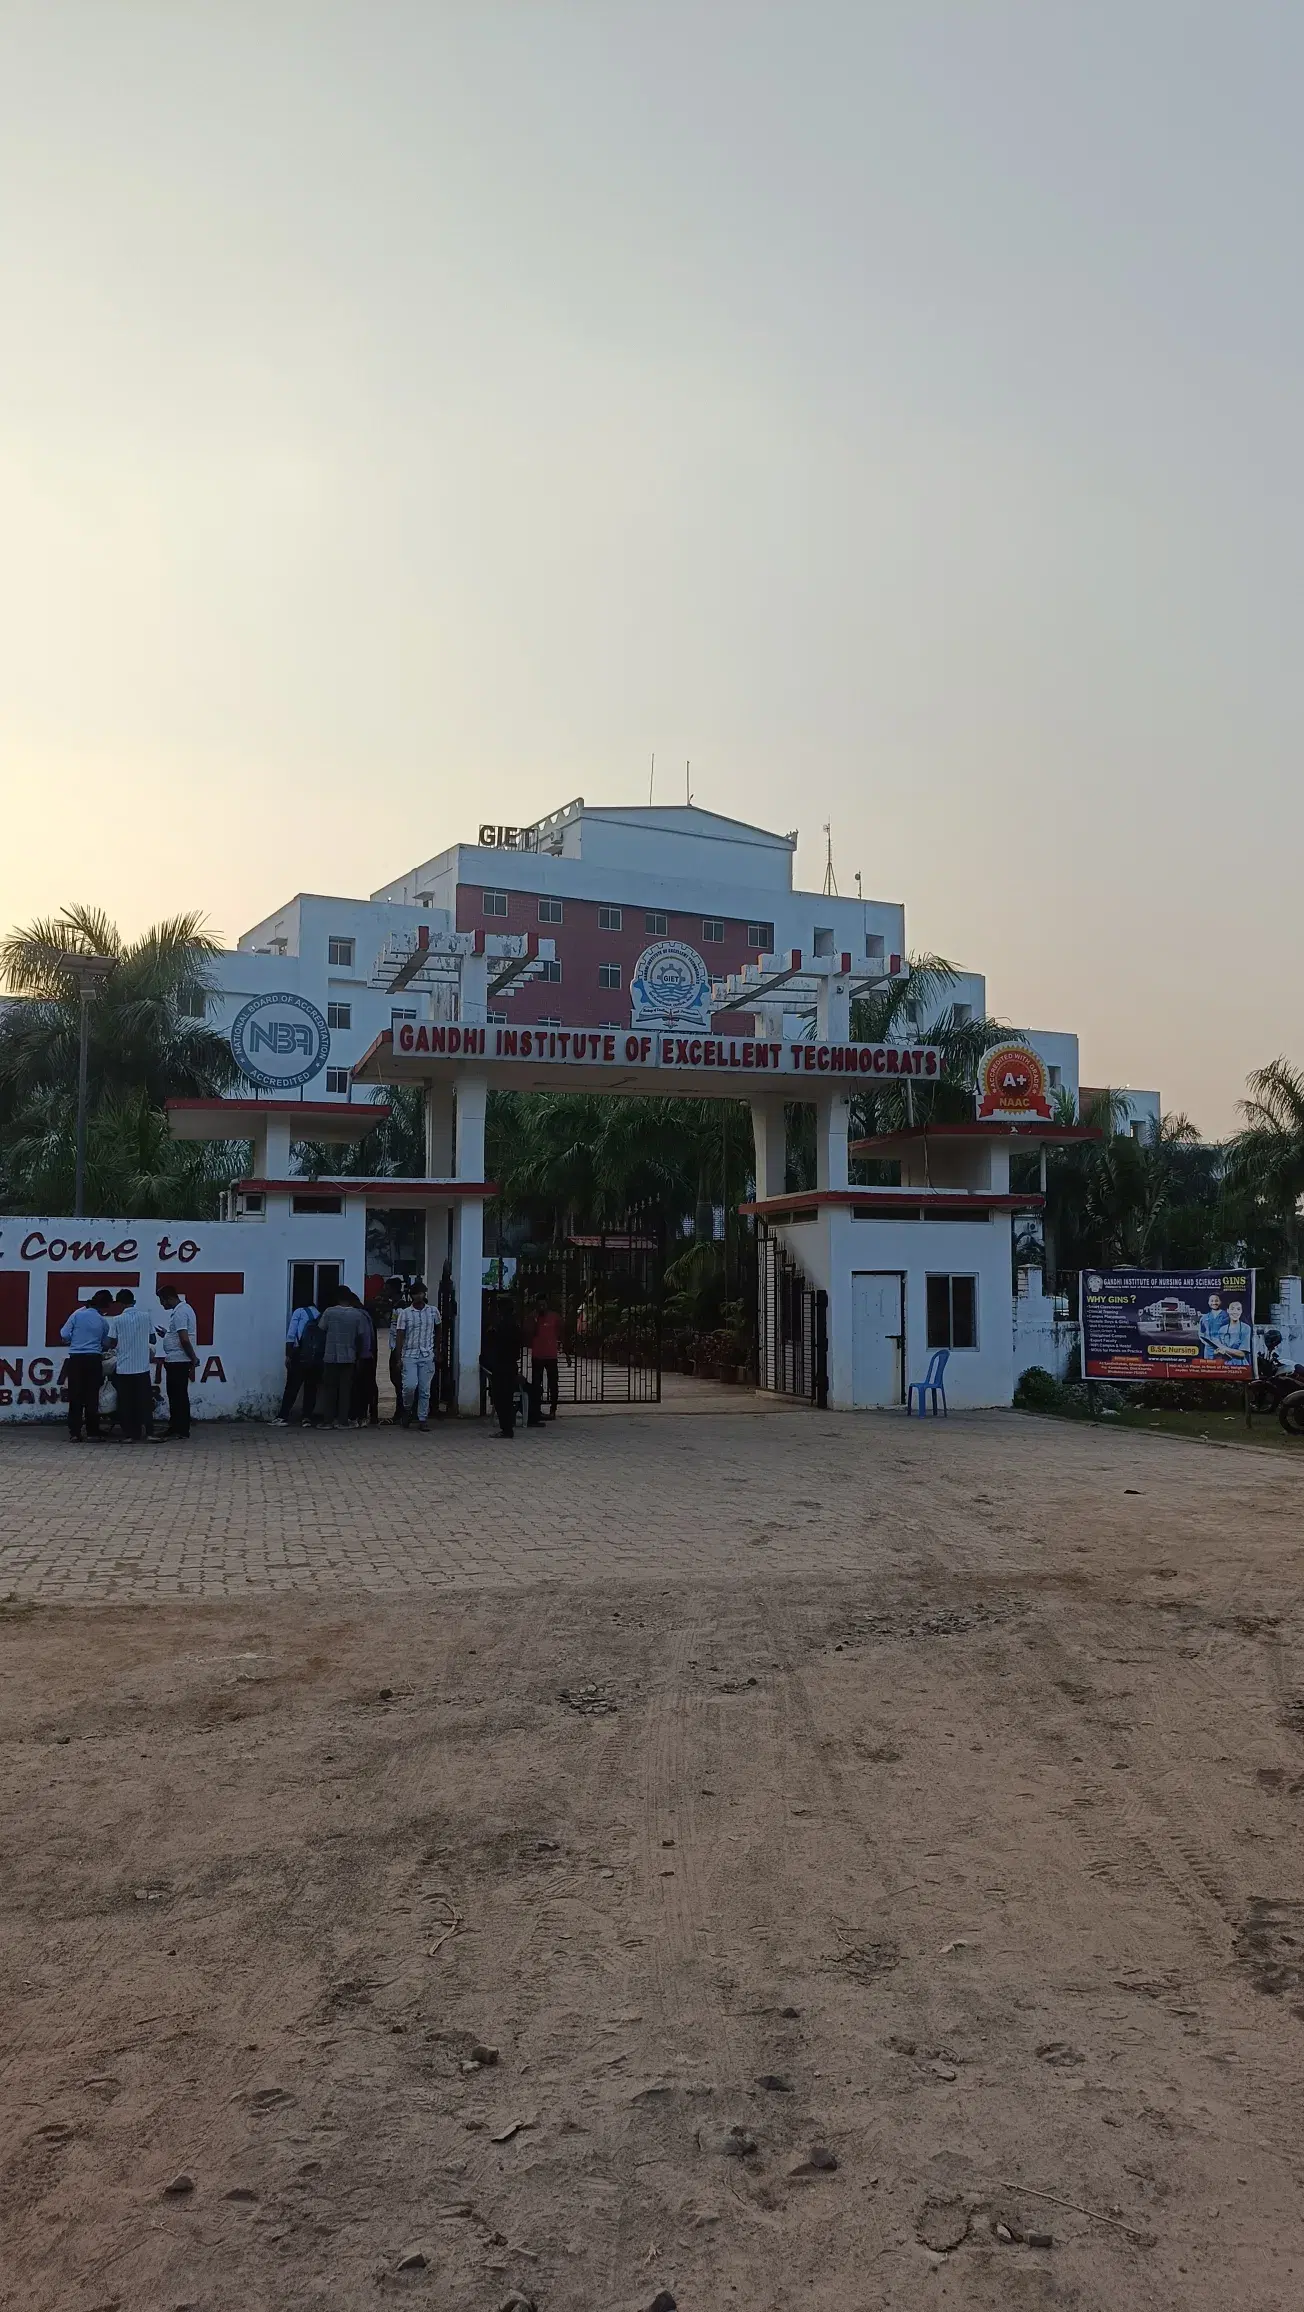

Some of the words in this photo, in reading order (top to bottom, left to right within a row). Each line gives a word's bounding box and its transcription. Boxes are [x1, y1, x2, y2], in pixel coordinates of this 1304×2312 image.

[480, 826, 536, 849] GIET
[234, 1011, 250, 1054] NATIONAL
[249, 995, 278, 1013] BOARD
[281, 995, 293, 1003] OF
[294, 999, 329, 1060] ACCREDITATION
[249, 1021, 313, 1055] NBA
[399, 1024, 486, 1054] GANDHI
[495, 1029, 616, 1061] INSTITUTE
[625, 1035, 652, 1062] OF
[663, 1038, 783, 1068] EXCELLENT
[791, 1044, 938, 1076] TECHNOCRATS
[250, 1069, 310, 1087] ACCREDITED
[989, 1053, 1013, 1088] ACCREDITED
[1014, 1053, 1030, 1064] WITH
[1029, 1064, 1039, 1088] GRADE
[1003, 1072, 1027, 1087] A+
[999, 1097, 1031, 1107] NAAC
[21, 1232, 138, 1262] Come
[156, 1236, 200, 1262] to
[1103, 1278, 1123, 1286] GANDHI
[1123, 1278, 1149, 1286] INSTITUTE
[1150, 1278, 1158, 1286] OF
[1159, 1278, 1182, 1286] NURSING
[1183, 1278, 1194, 1286] AND
[1195, 1278, 1221, 1286] SCIENCES
[1222, 1276, 1246, 1285] GINS
[1086, 1295, 1106, 1304] WHY
[1108, 1296, 1129, 1304] GINS
[1130, 1294, 1137, 1304] ?
[1168, 1346, 1196, 1355] Nursing
